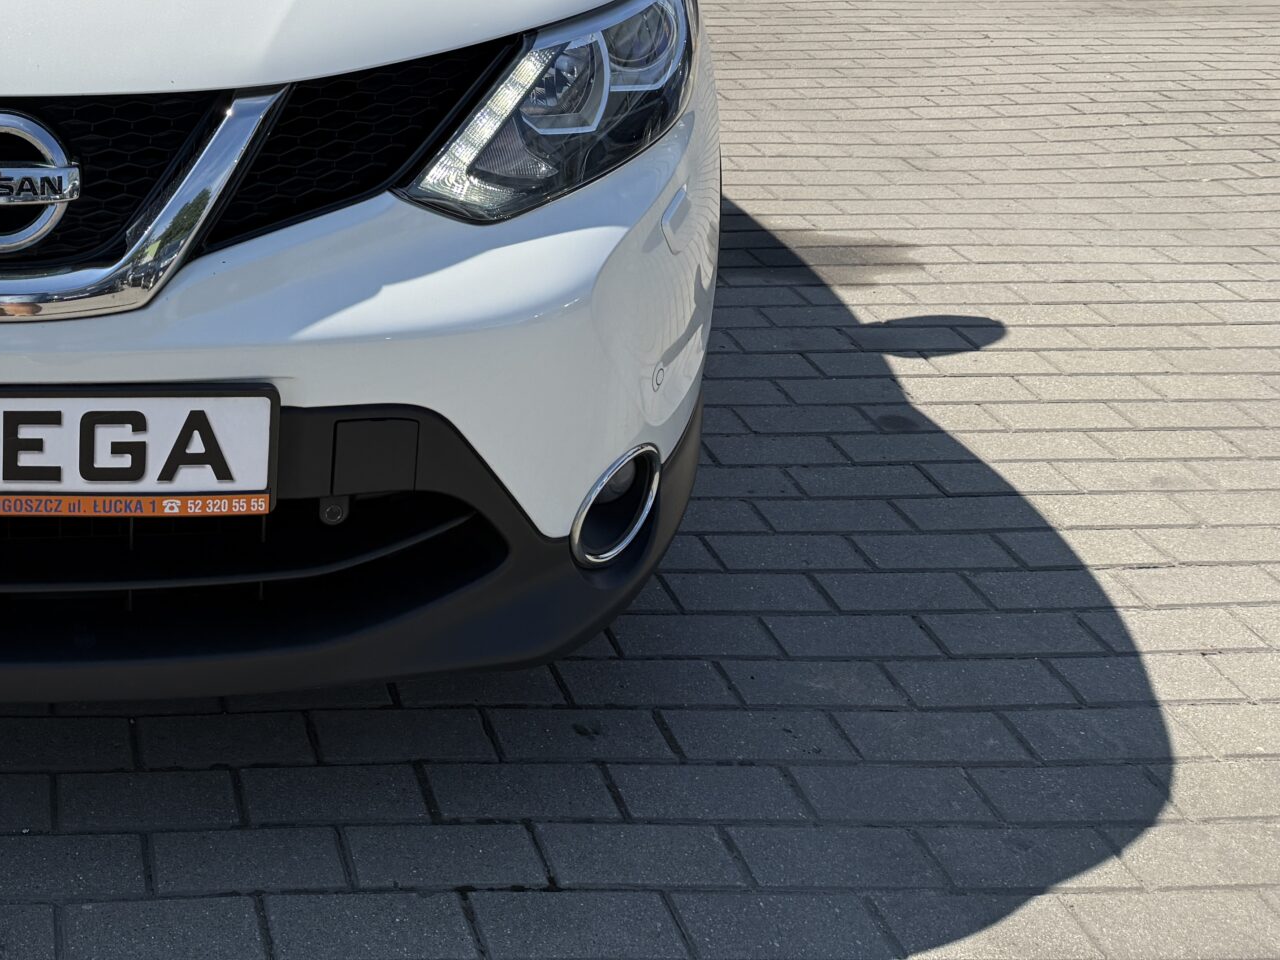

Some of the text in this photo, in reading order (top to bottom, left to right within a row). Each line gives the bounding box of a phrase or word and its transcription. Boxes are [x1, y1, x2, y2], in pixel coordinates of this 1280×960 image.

[67, 498, 86, 513] ul.
[93, 498, 144, 513] ŁUCKA
[149, 498, 157, 513] 1
[187, 499, 202, 513] 52
[206, 498, 228, 512] 320
[232, 498, 247, 512] 55
[250, 497, 266, 511] 55
